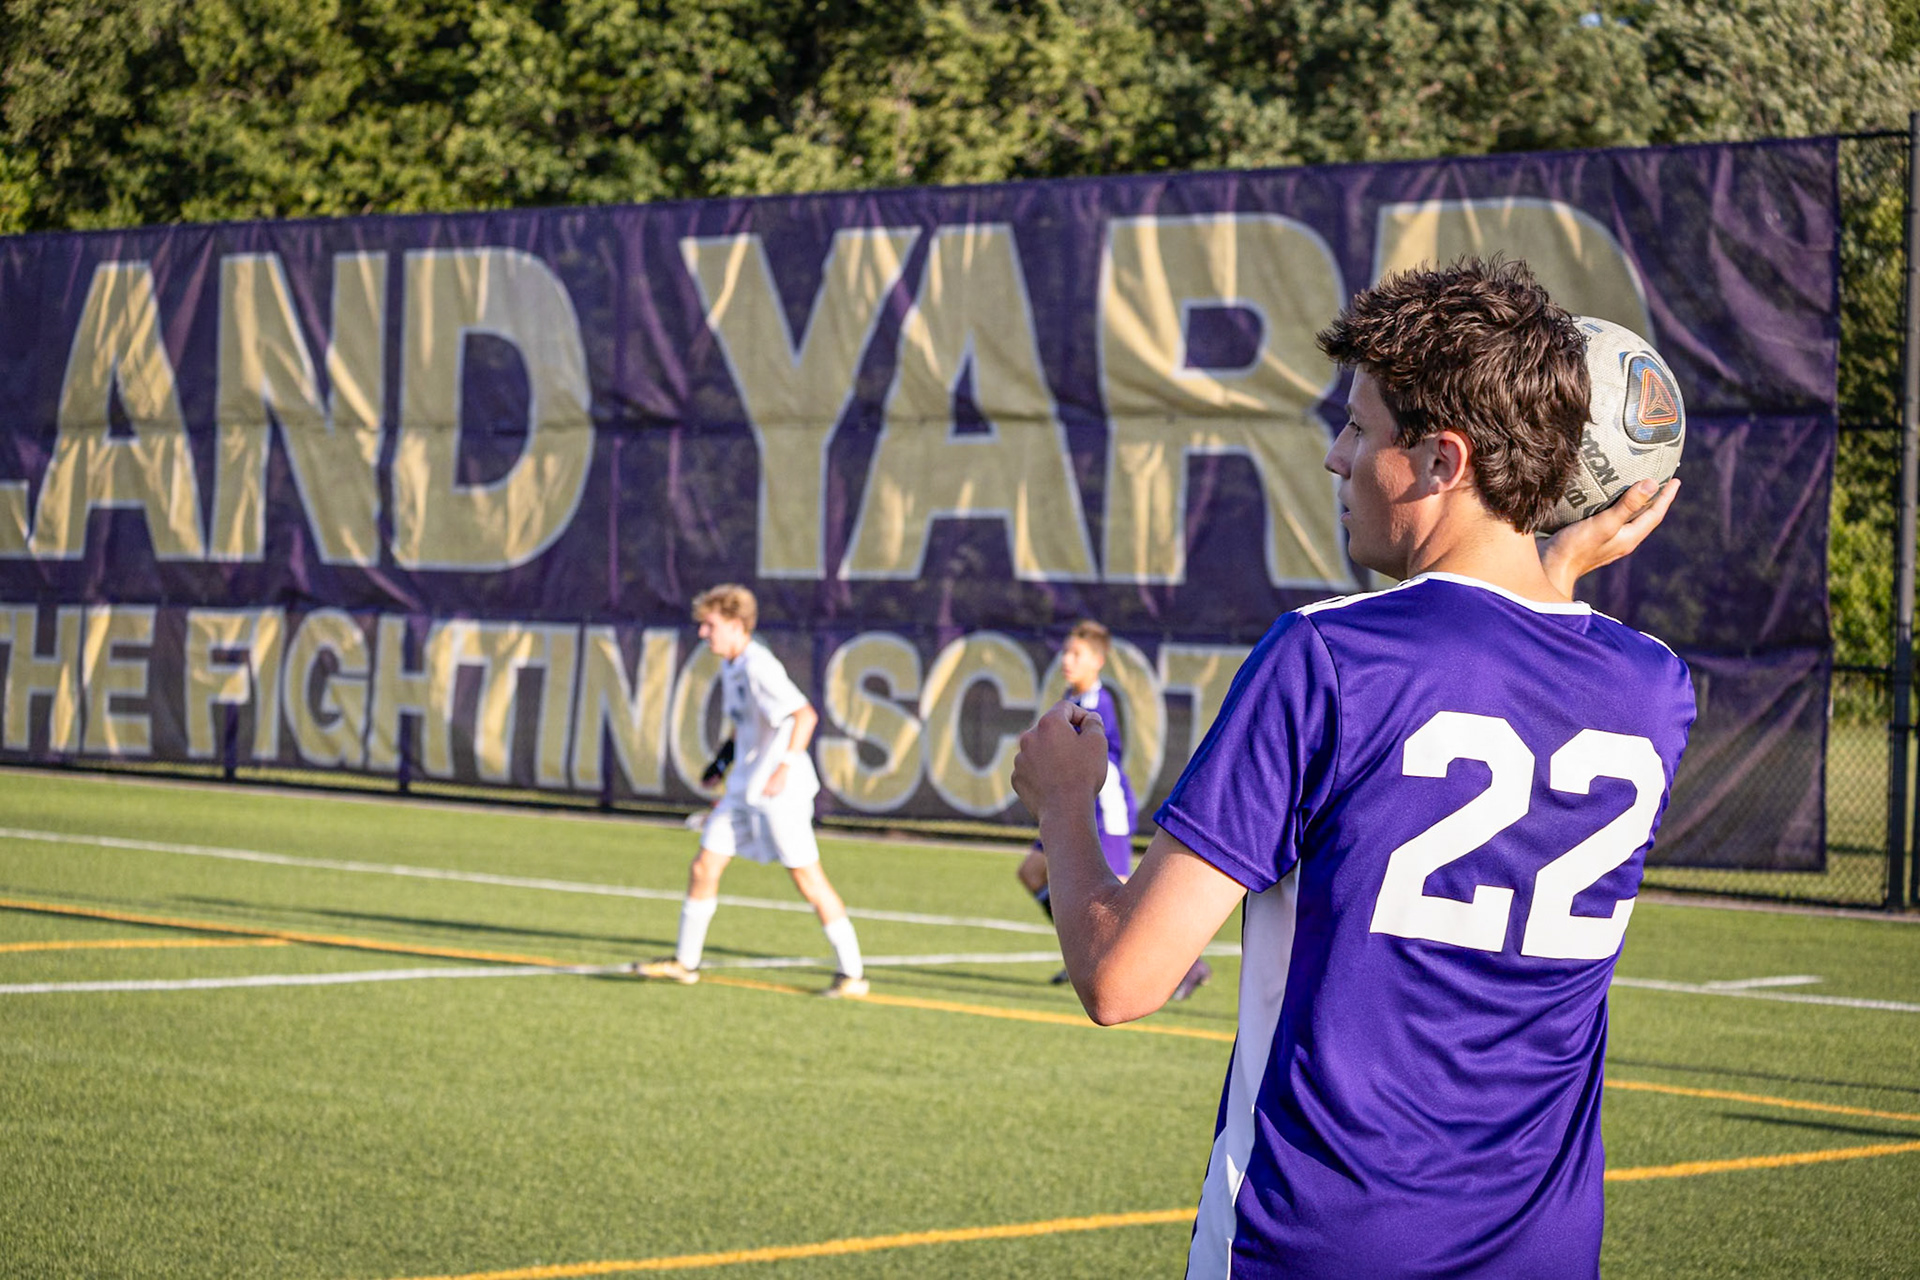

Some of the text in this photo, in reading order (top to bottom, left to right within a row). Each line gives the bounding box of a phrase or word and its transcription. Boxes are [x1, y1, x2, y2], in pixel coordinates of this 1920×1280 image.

[0, 247, 596, 571] AND
[0, 603, 156, 753] HE
[1369, 710, 1666, 960] 22
